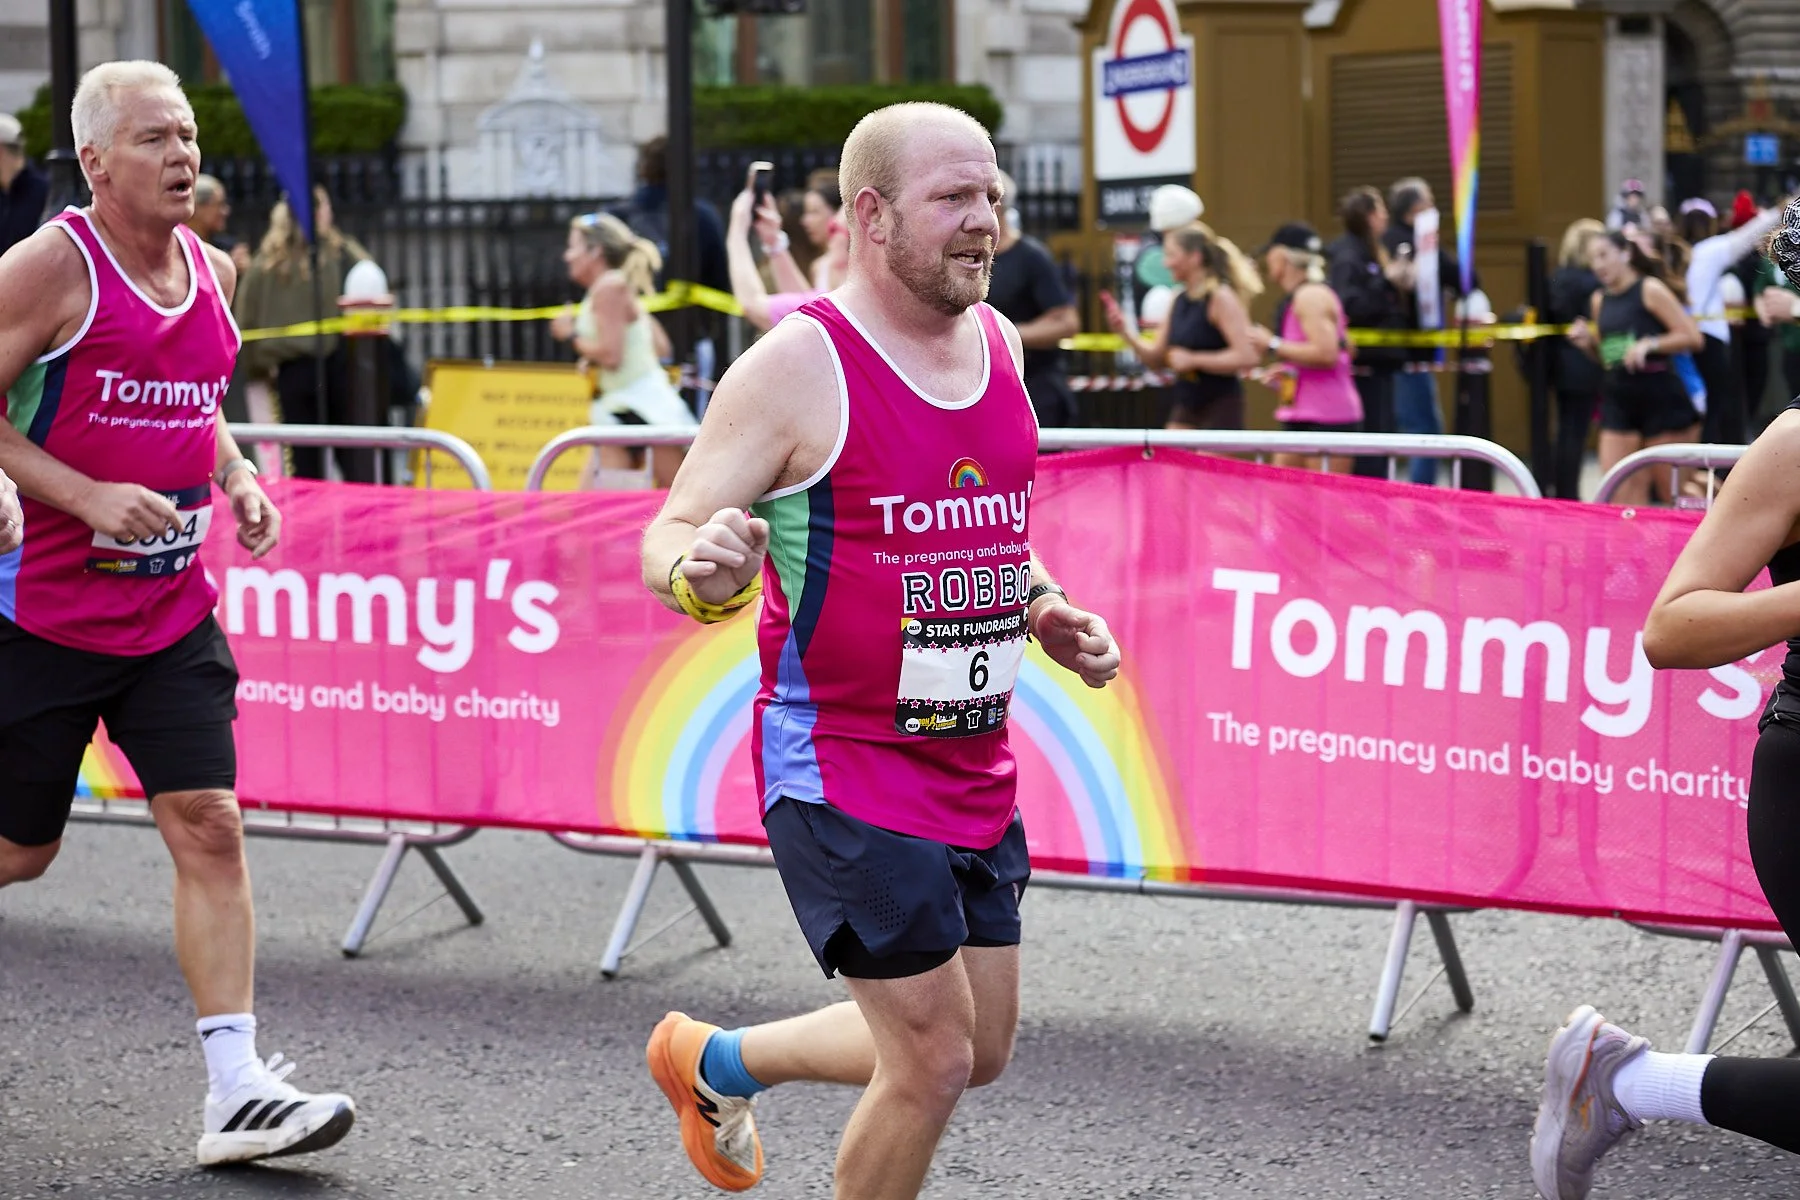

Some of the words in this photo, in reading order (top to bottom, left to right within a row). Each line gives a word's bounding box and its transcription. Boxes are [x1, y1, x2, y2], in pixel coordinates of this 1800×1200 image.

[88, 412, 108, 424] The
[869, 481, 1033, 535] Tommy'
[873, 552, 900, 565] The
[904, 549, 974, 566] pregnancy
[976, 545, 997, 558] and
[999, 541, 1022, 556] baby
[901, 560, 1031, 614] ROBBO
[204, 559, 560, 673] mmy's
[926, 624, 960, 638] STAR
[963, 615, 1020, 636] FUNDRAISER
[969, 650, 989, 692] 6
[1212, 568, 1765, 738] Tommys
[311, 681, 364, 711] and
[372, 682, 447, 722] baby
[454, 687, 560, 727] charity
[1206, 711, 1260, 747] The
[1269, 725, 1436, 774] pregnancy
[1445, 742, 1510, 776] and
[1522, 744, 1614, 795] baby
